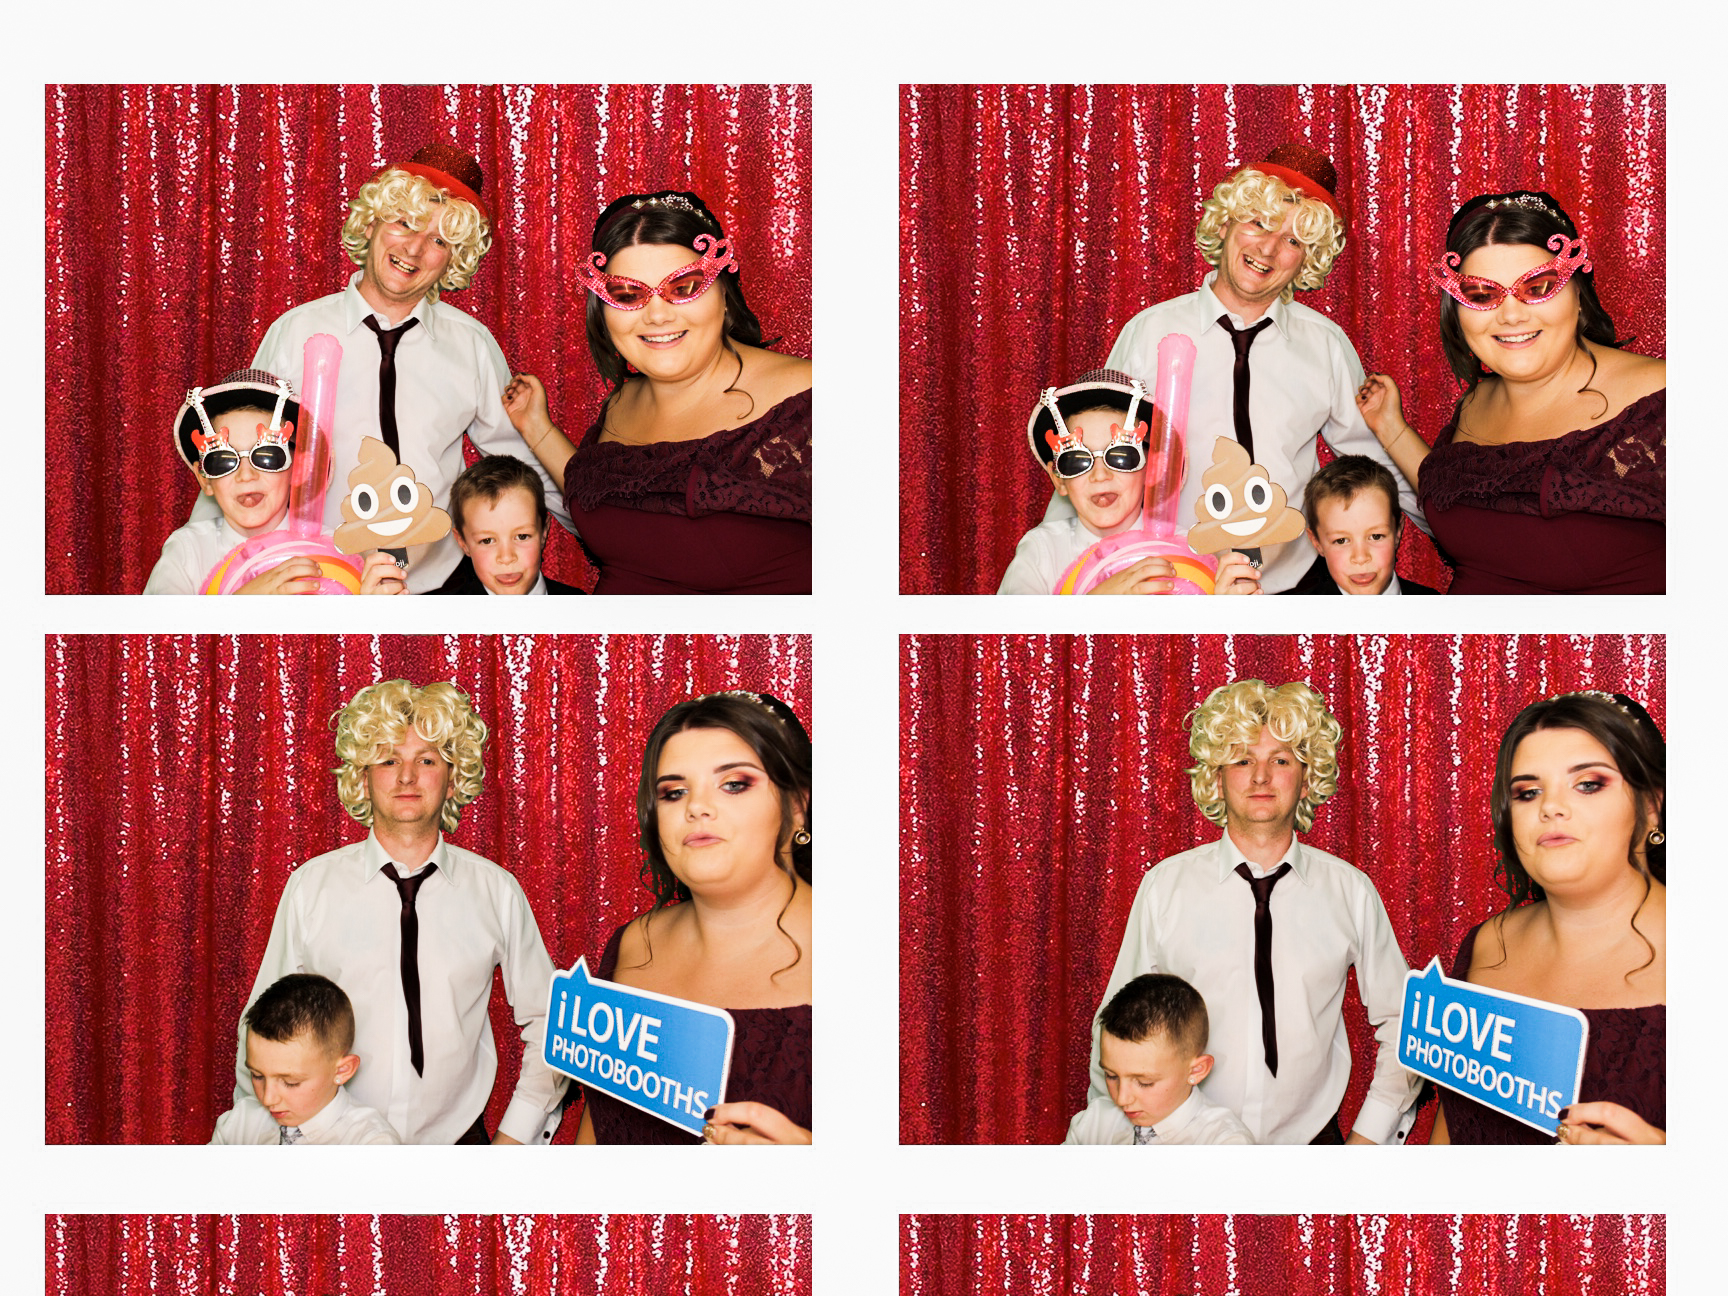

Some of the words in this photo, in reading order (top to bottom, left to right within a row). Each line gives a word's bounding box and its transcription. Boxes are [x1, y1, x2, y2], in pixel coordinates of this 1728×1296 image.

[557, 990, 567, 1029] i
[571, 996, 661, 1062] LOVE
[1411, 990, 1421, 1029] i
[1425, 996, 1515, 1062] LOVE
[552, 1035, 709, 1119] PHOTOBOOTHS
[1406, 1035, 1563, 1119] PHOTOBOOTHS
